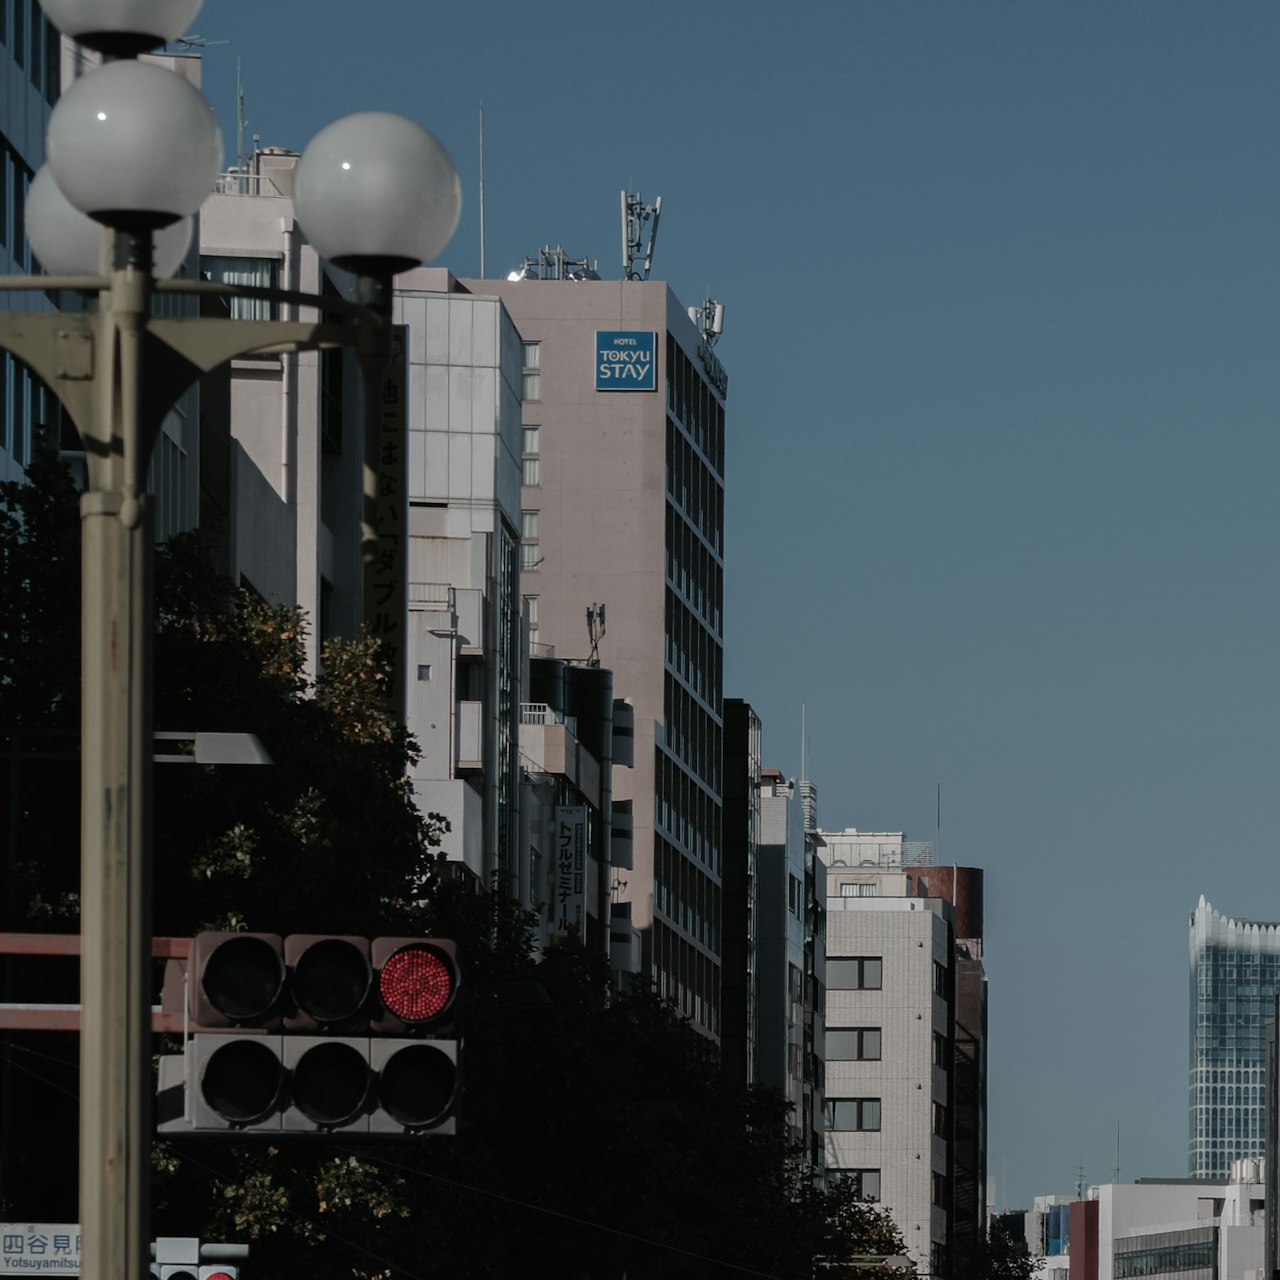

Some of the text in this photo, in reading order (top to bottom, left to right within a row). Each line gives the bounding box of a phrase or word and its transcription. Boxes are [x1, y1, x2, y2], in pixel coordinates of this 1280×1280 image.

[613, 338, 637, 346] HOTEL
[600, 350, 650, 363] TOKYU
[600, 364, 650, 381] STAY
